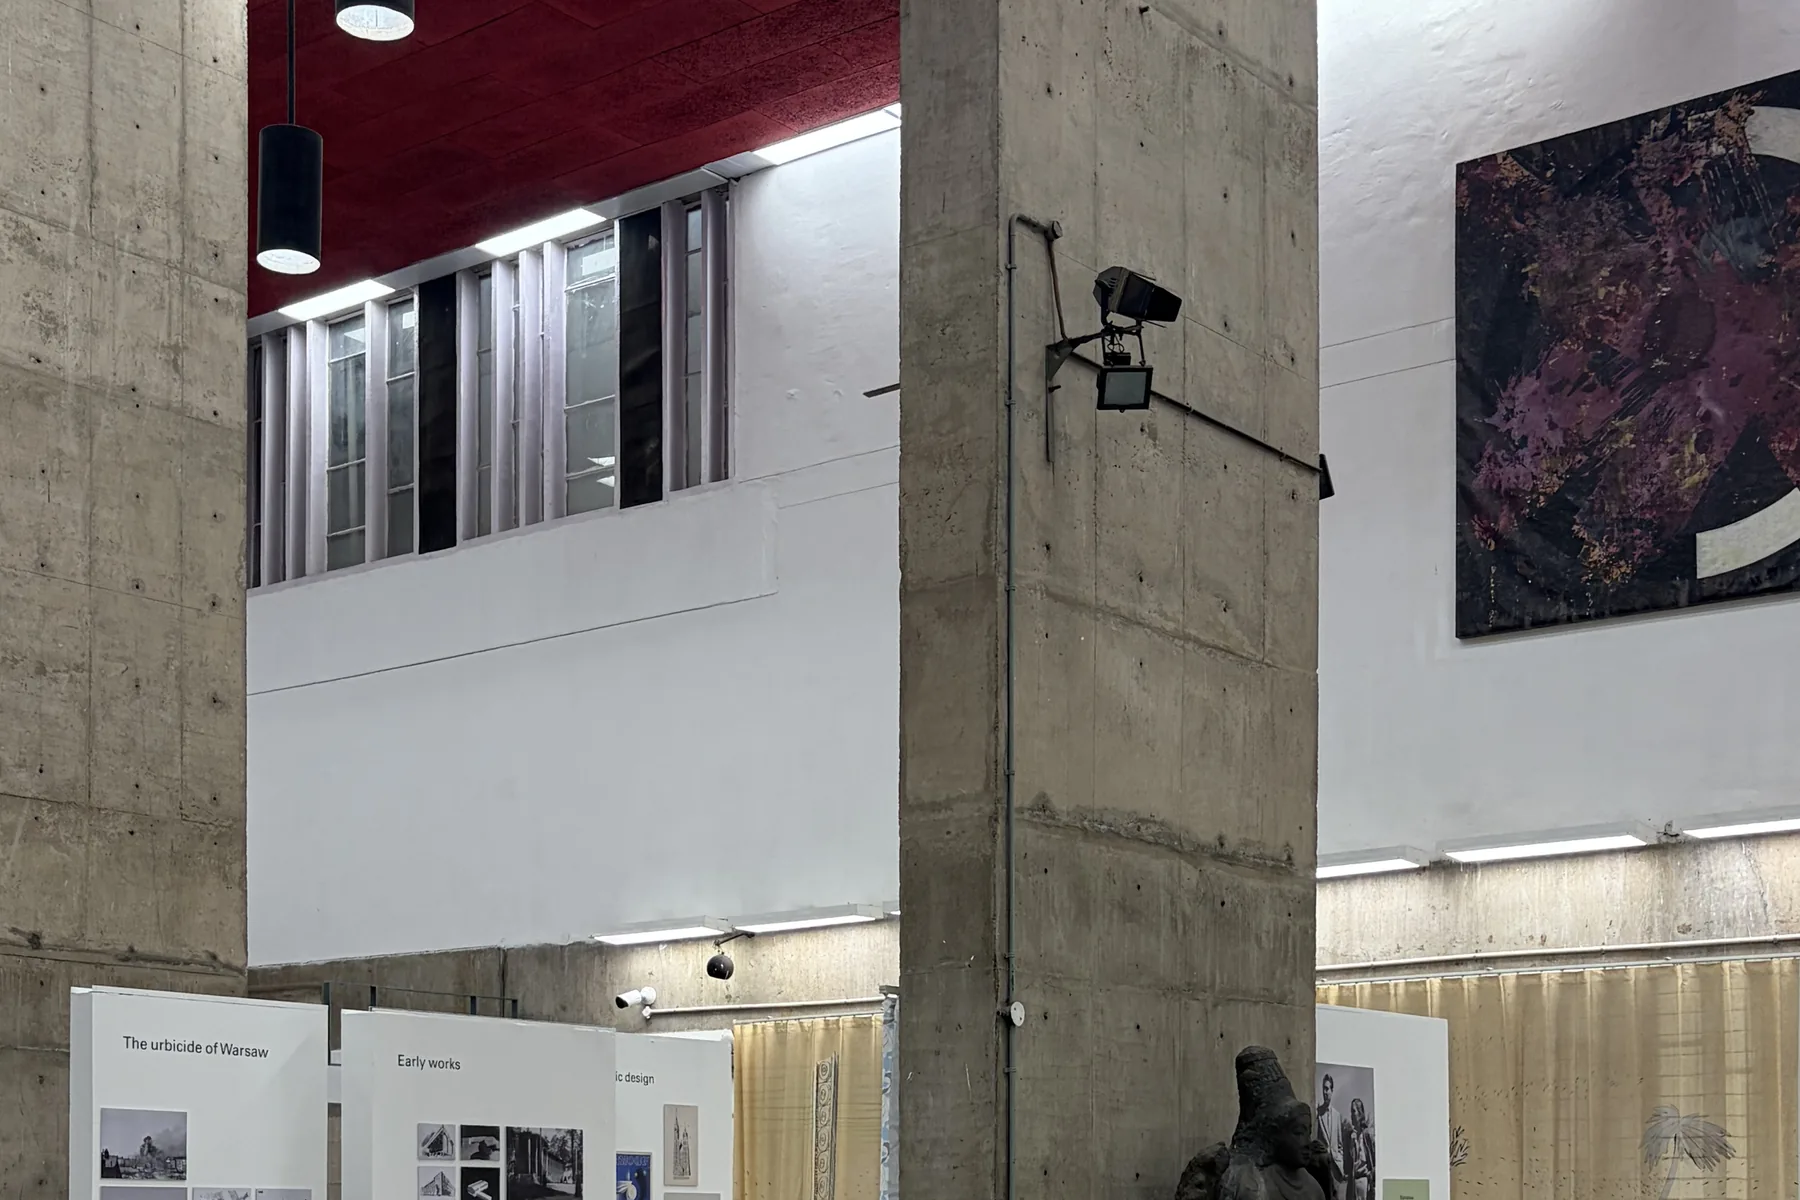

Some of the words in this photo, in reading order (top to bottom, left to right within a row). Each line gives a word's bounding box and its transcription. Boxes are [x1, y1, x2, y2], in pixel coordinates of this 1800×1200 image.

[123, 1035, 148, 1050] The
[151, 1039, 202, 1054] urbicide
[205, 1042, 218, 1055] of
[220, 1042, 269, 1058] Warsaw
[398, 1054, 426, 1071] Early
[428, 1057, 461, 1070] works
[624, 1071, 655, 1086] design
